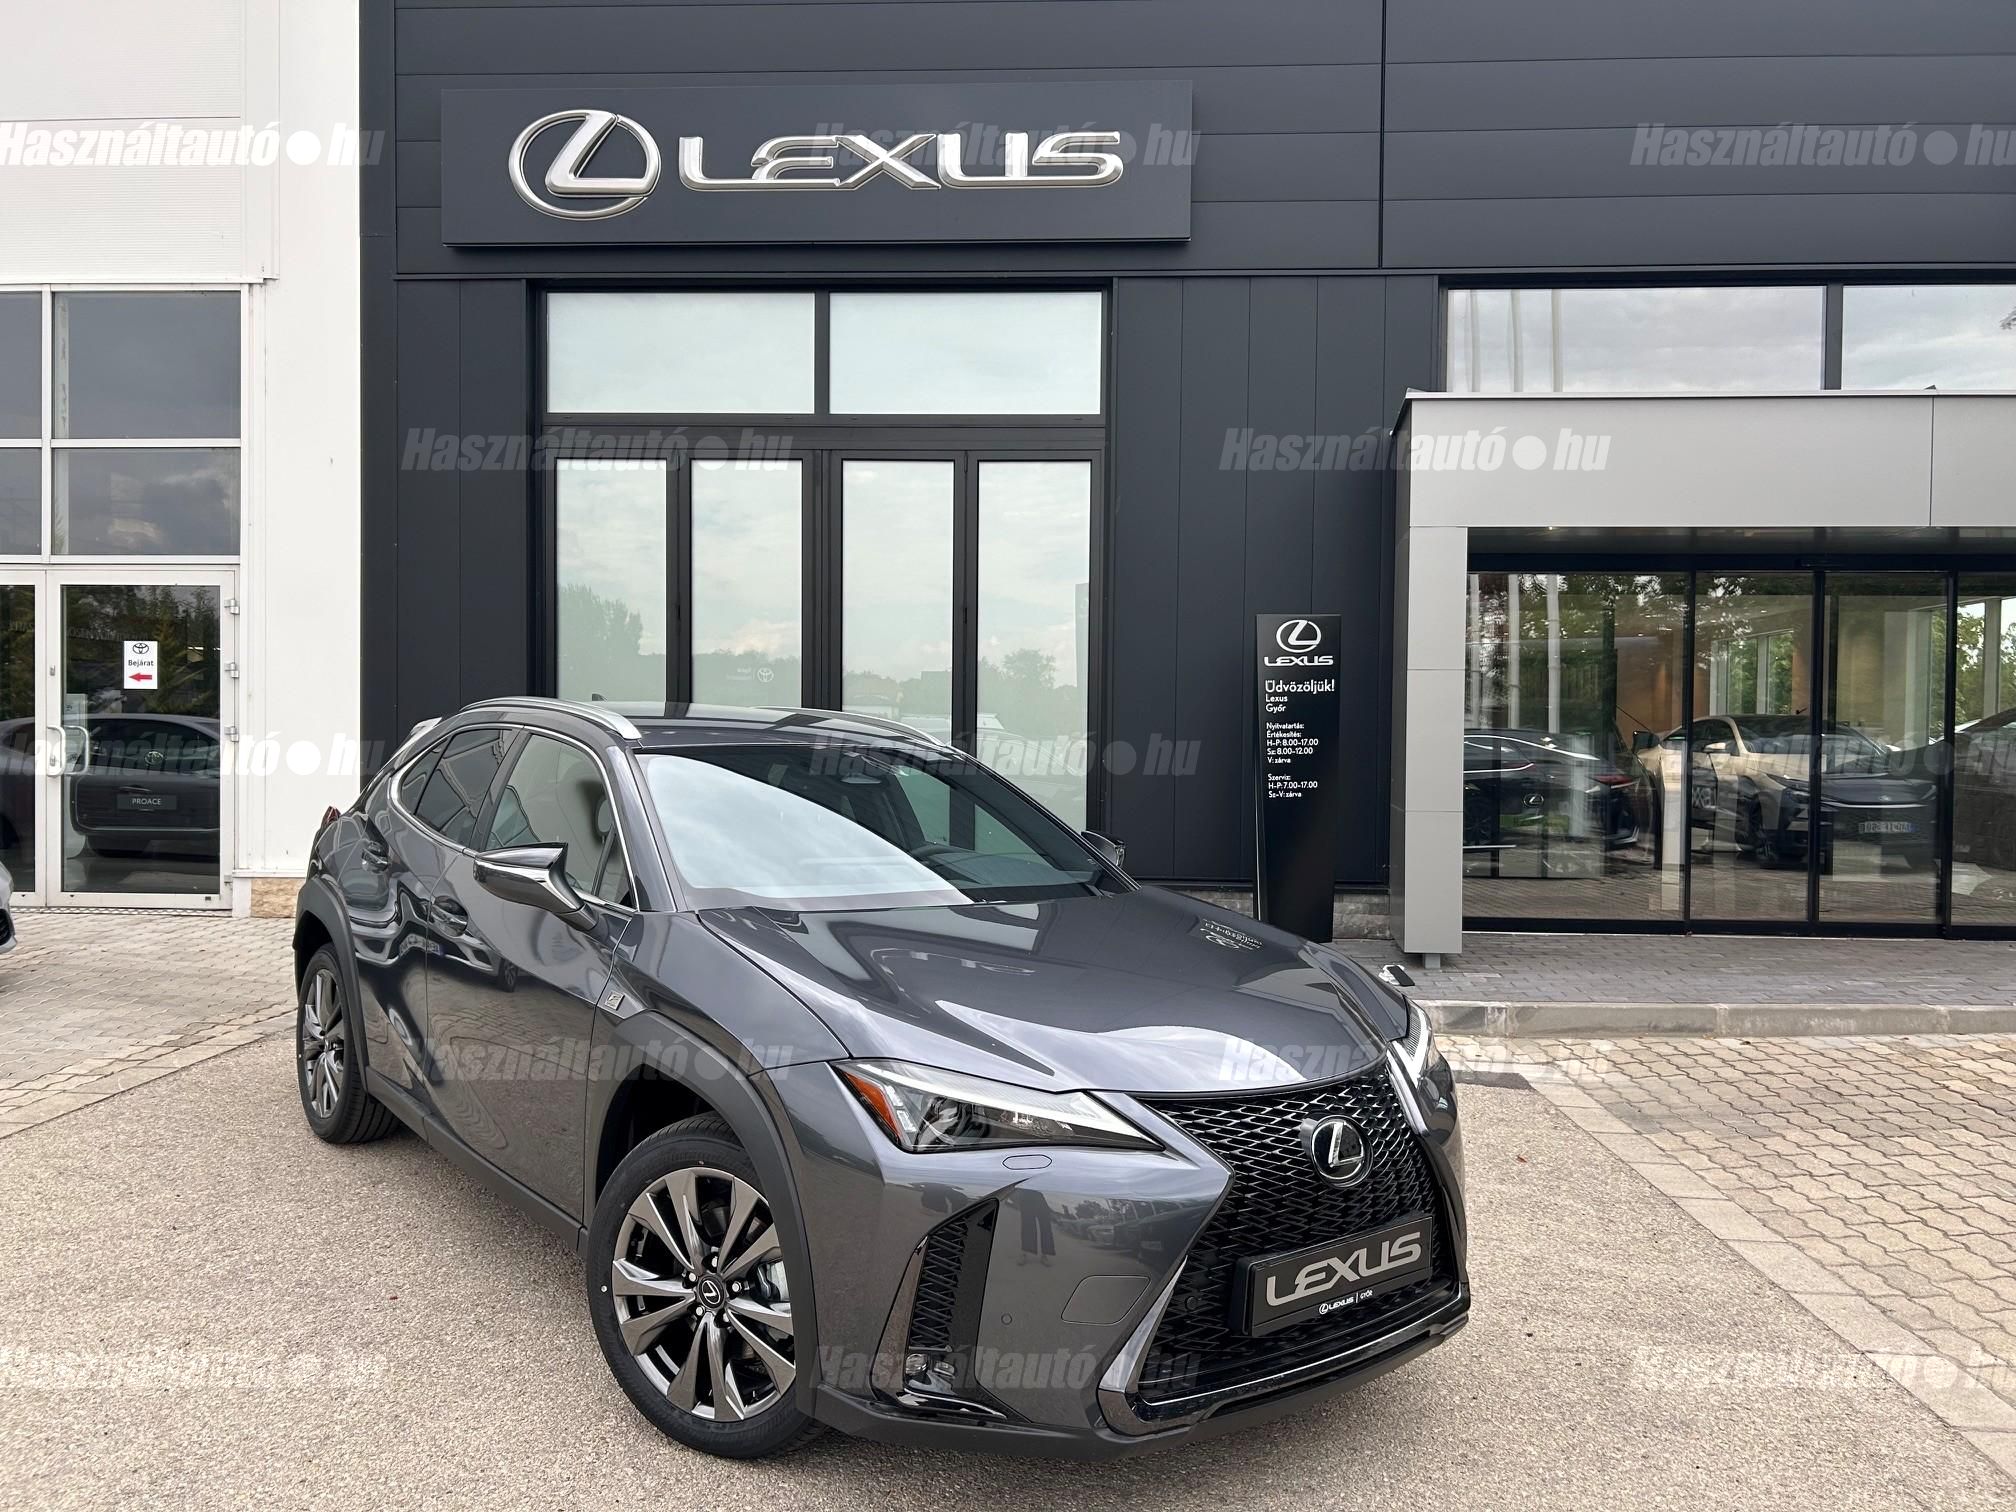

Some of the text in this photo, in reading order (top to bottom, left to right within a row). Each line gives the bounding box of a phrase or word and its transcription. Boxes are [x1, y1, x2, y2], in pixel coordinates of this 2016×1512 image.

[678, 131, 1124, 191] LEXUS
[128, 659, 154, 667] Bejárat
[1263, 656, 1334, 667] LEXUS
[1265, 679, 1335, 694] Üdvözöljük!
[1265, 693, 1288, 703] Lexus
[1266, 1231, 1422, 1307] LEXUS
